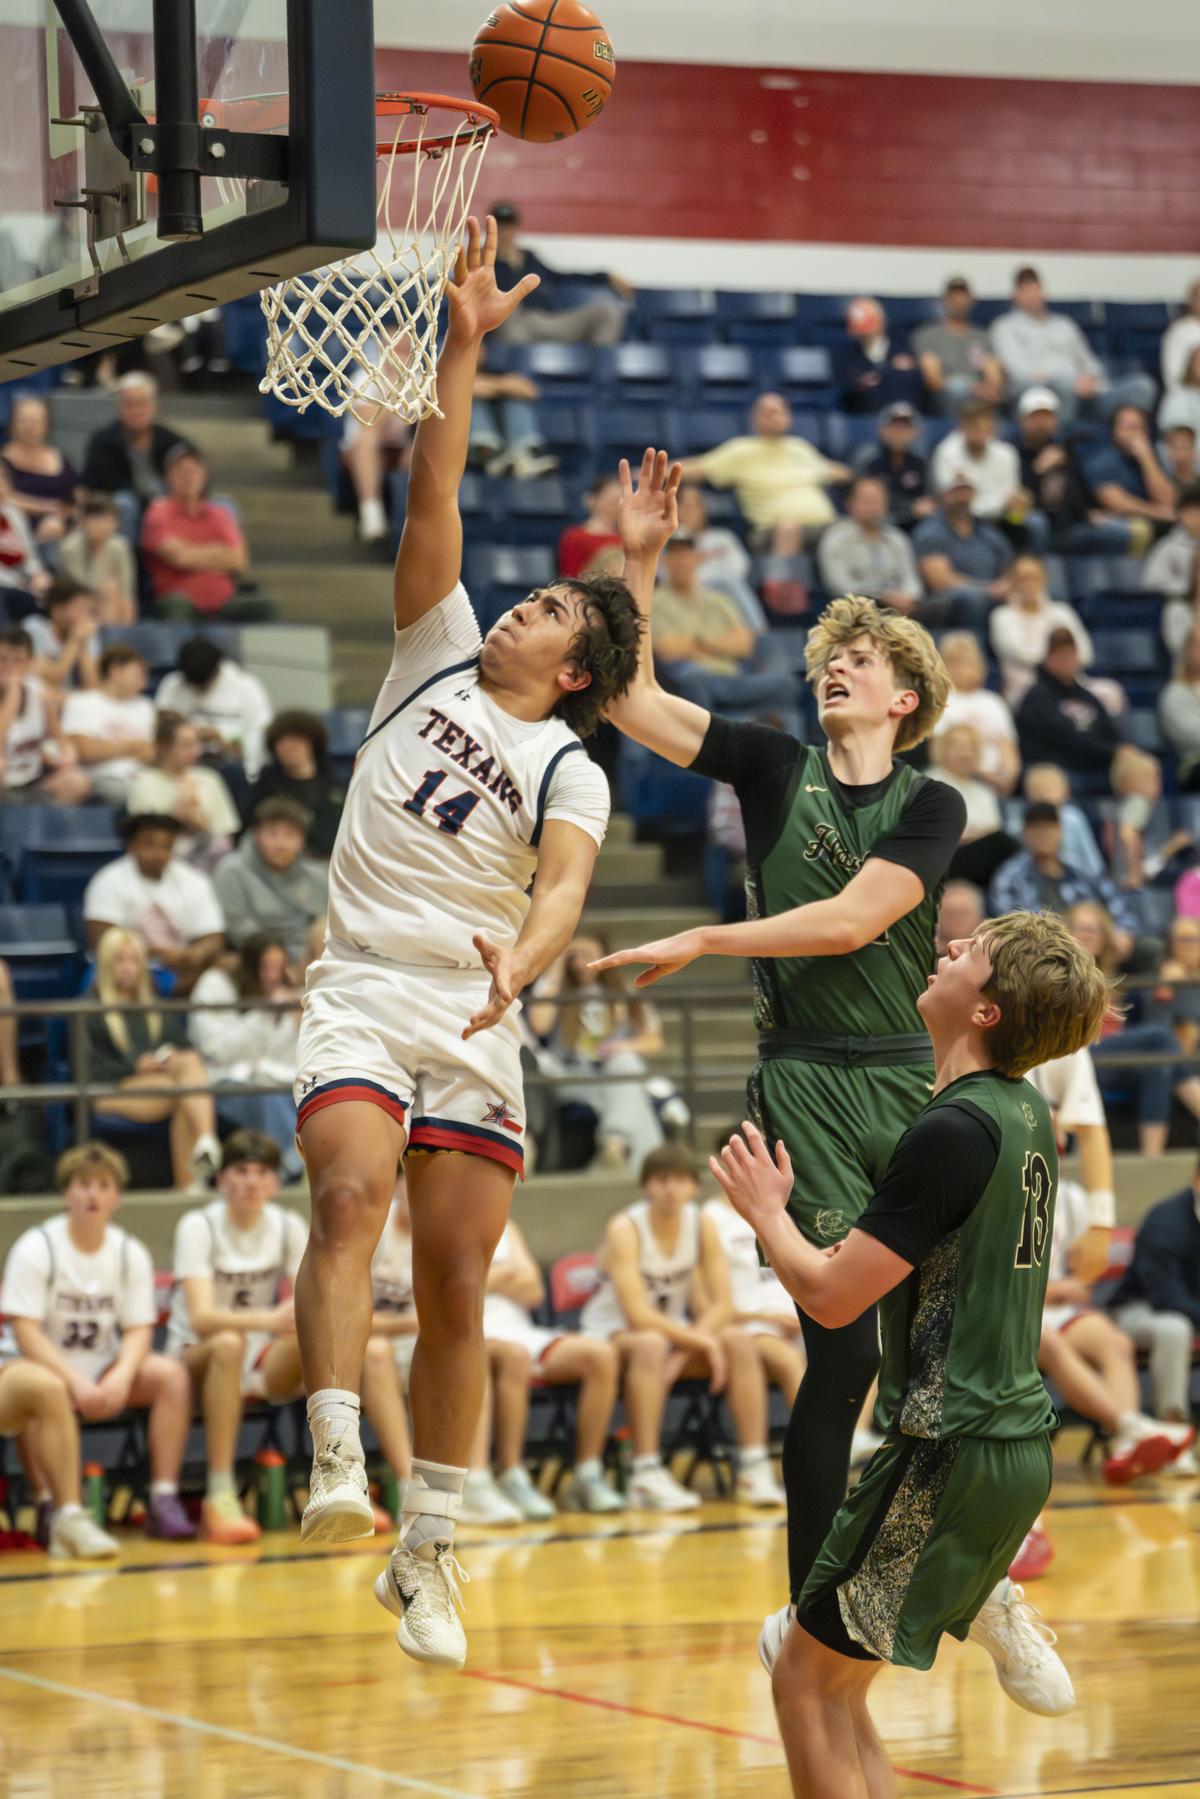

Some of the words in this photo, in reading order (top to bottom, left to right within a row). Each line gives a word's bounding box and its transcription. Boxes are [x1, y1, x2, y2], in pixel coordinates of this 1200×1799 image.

[402, 768, 482, 836] 14
[418, 708, 523, 815] TEXANS
[1014, 1150, 1053, 1268] 13
[61, 1321, 99, 1350] 32
